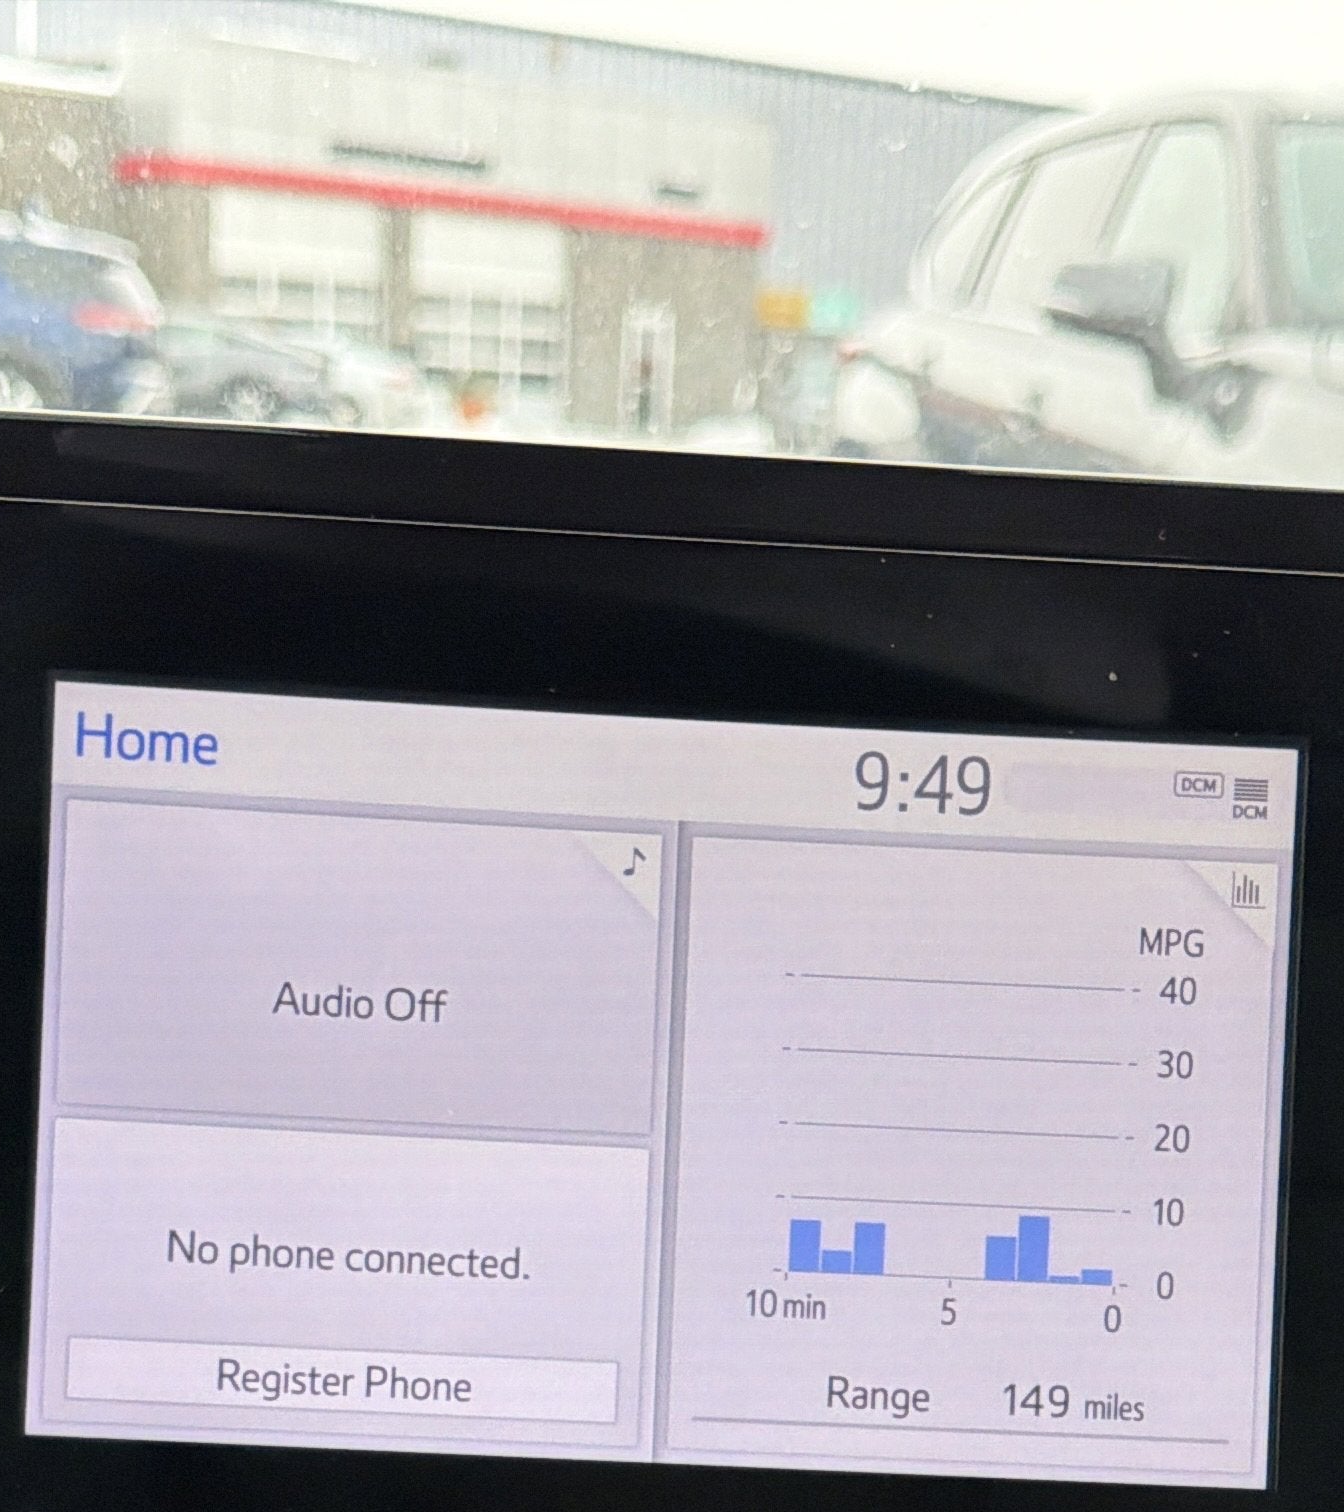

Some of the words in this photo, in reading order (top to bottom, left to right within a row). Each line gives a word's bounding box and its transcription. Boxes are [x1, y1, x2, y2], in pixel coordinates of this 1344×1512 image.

[75, 711, 219, 766] Home
[854, 750, 992, 817] 9:49
[1181, 777, 1217, 793] DCM
[1232, 804, 1268, 820] DCM
[1139, 927, 1205, 958] MPG
[272, 980, 375, 1021] Audio
[384, 988, 449, 1023] Off
[1159, 976, 1198, 1006] 40
[1156, 1050, 1194, 1080] 30
[1153, 1124, 1191, 1153] 20
[1154, 1198, 1185, 1227] 10
[166, 1230, 219, 1265] No
[229, 1235, 334, 1274] phone
[344, 1247, 532, 1280] connected.
[1156, 1272, 1175, 1300] 0
[746, 1289, 779, 1318] 10
[783, 1293, 827, 1322] min
[940, 1299, 957, 1326] 5
[1103, 1304, 1122, 1333] 0
[217, 1358, 354, 1401] Register
[365, 1365, 472, 1402] Phone
[827, 1375, 930, 1418] Range
[1002, 1384, 1070, 1418] 149
[1084, 1395, 1144, 1422] miles
